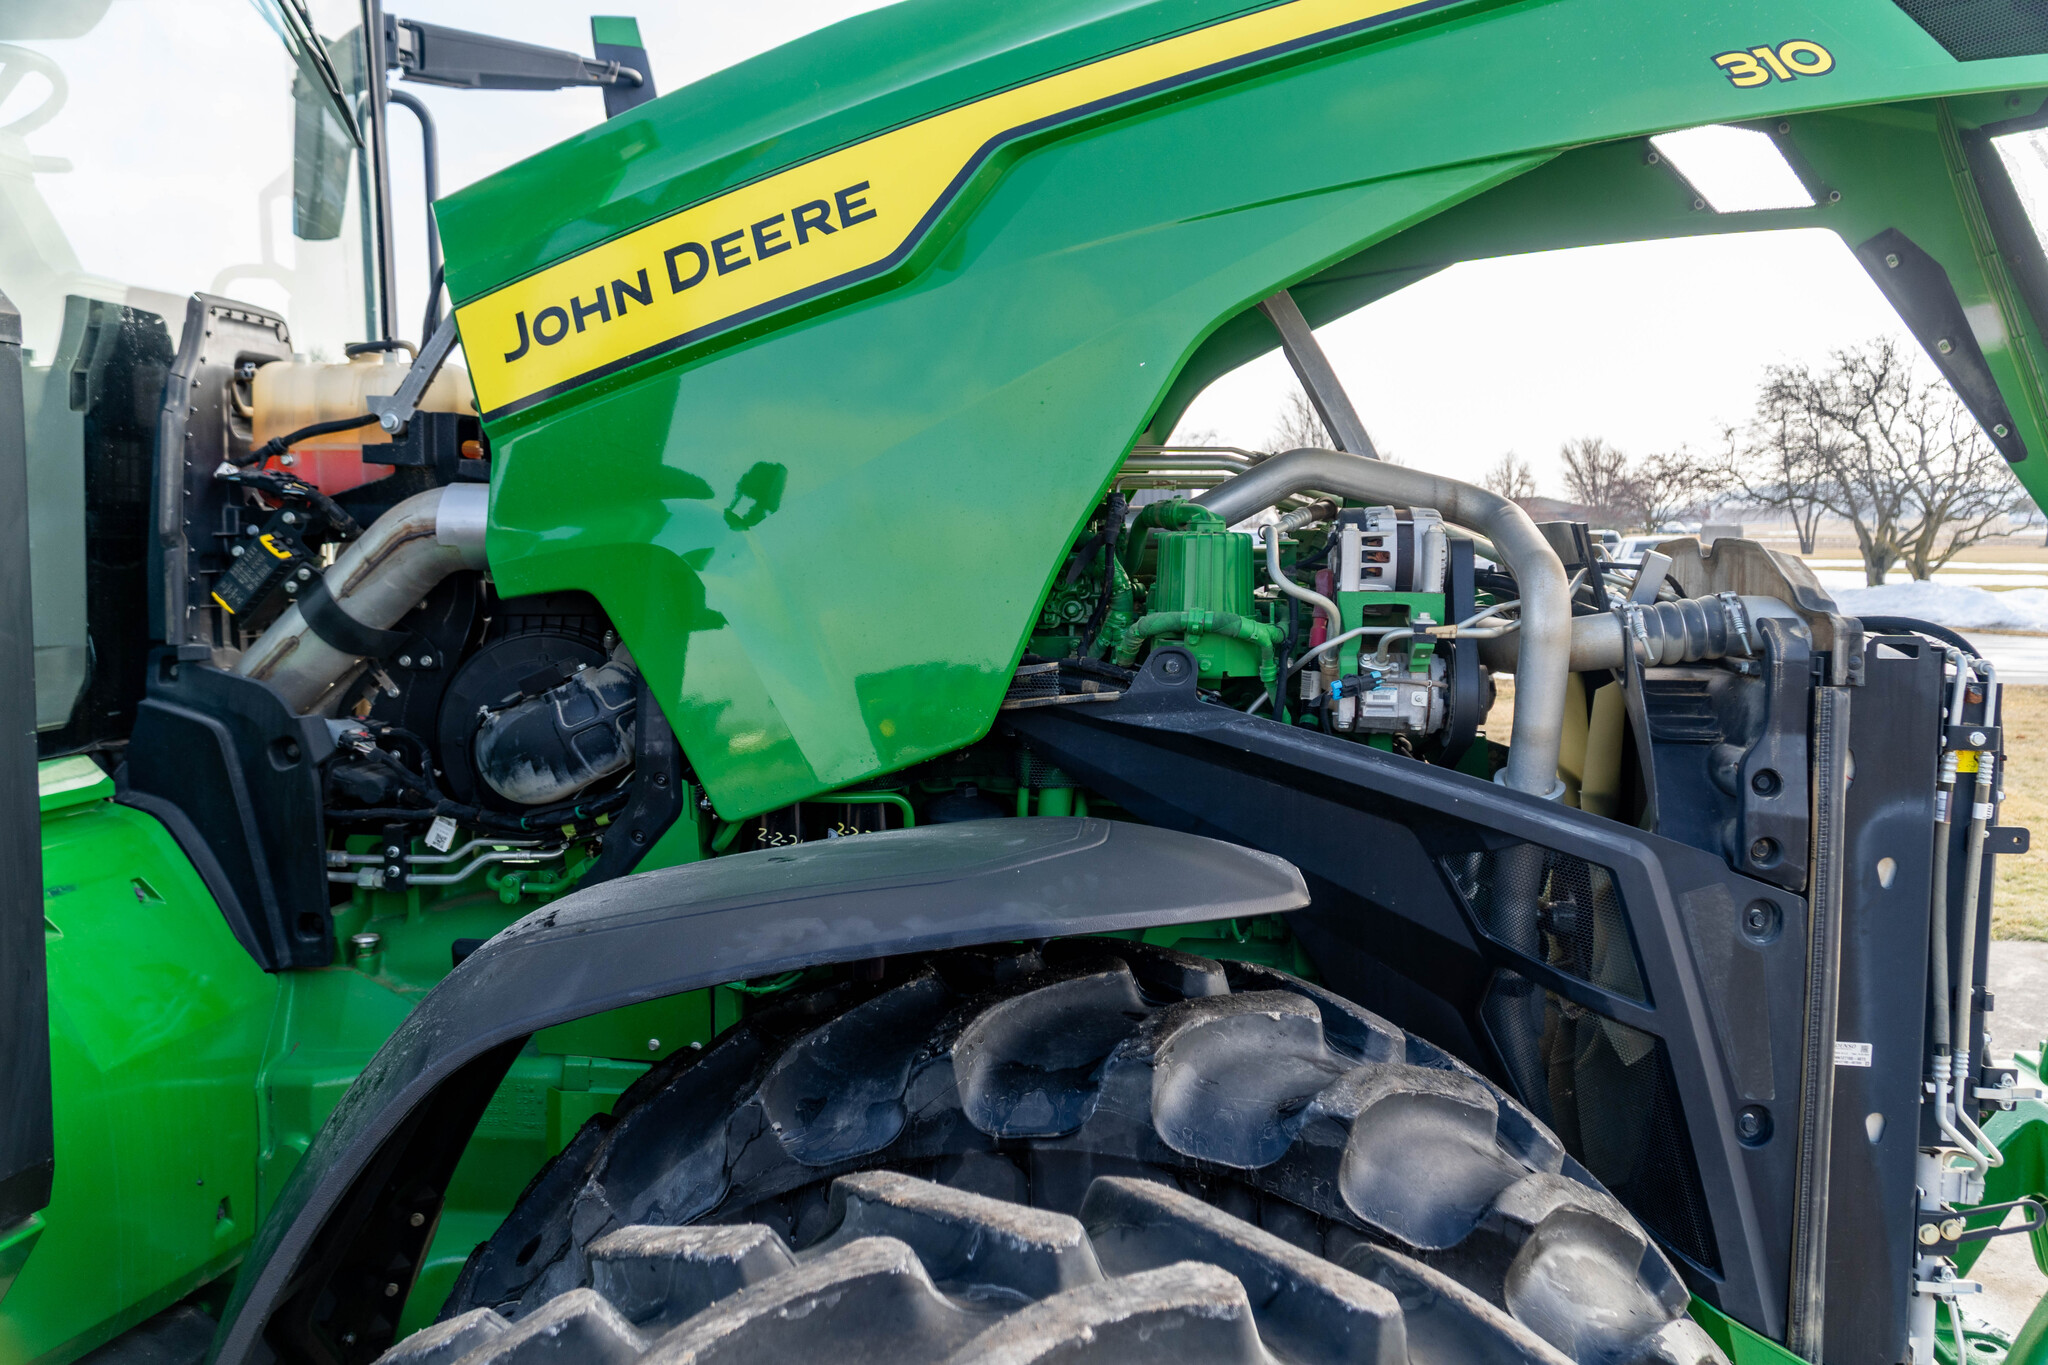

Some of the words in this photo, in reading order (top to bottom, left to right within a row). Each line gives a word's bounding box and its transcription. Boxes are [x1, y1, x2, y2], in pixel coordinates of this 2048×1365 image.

[1712, 39, 1836, 88] 310
[504, 267, 653, 364] JOHN
[663, 180, 878, 295] DEERE
